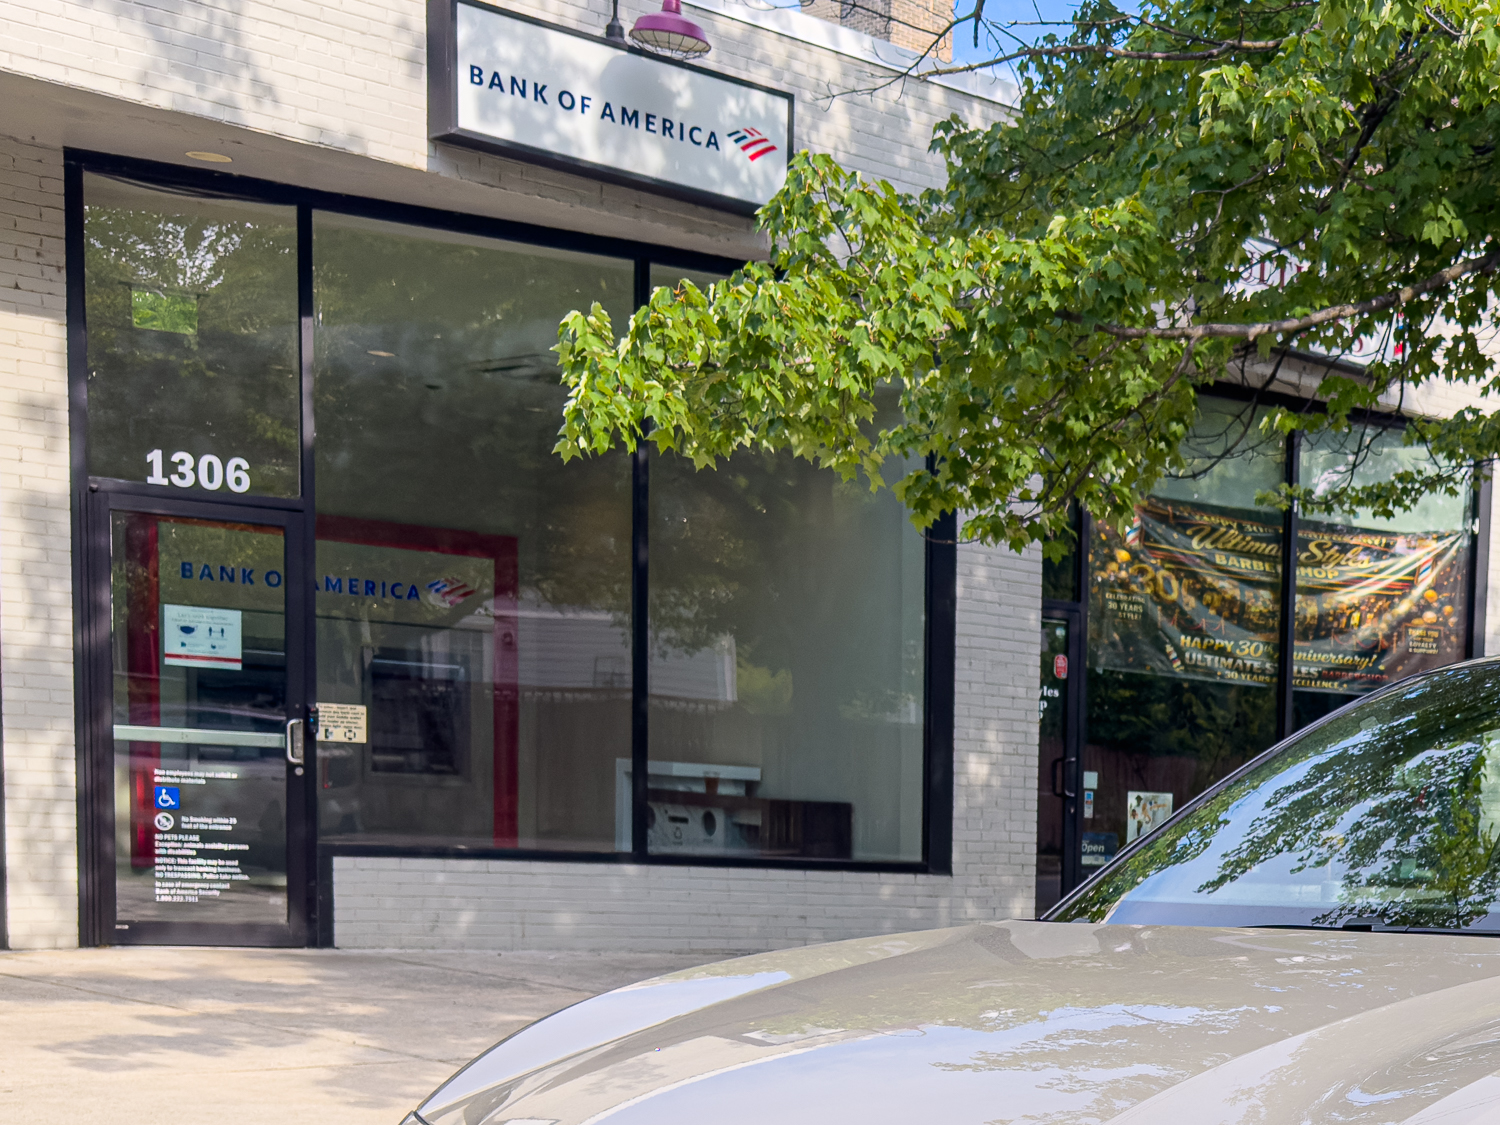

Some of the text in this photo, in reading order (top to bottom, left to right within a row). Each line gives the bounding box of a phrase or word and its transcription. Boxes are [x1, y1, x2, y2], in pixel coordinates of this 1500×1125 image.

[470, 64, 720, 151] BANK OF AMERICA
[146, 448, 251, 493] 1306
[1186, 525, 1299, 558] Ultima
[1301, 539, 1374, 569] Styles
[1215, 553, 1339, 580] BARBEHOP
[180, 561, 420, 601] BANK O MERICA
[1119, 602, 1143, 613] YEARS
[1180, 634, 1378, 671] HAPPY 30th nniversary!
[1184, 651, 1262, 673] ULTIMATE
[1265, 660, 1322, 679] SLES'
[1224, 670, 1239, 680] 30
[1241, 673, 1271, 683] YEARS
[1292, 678, 1340, 689] CELLENCE
[154, 833, 200, 842] NO PETS PLEASE
[1081, 843, 1105, 853] Open
